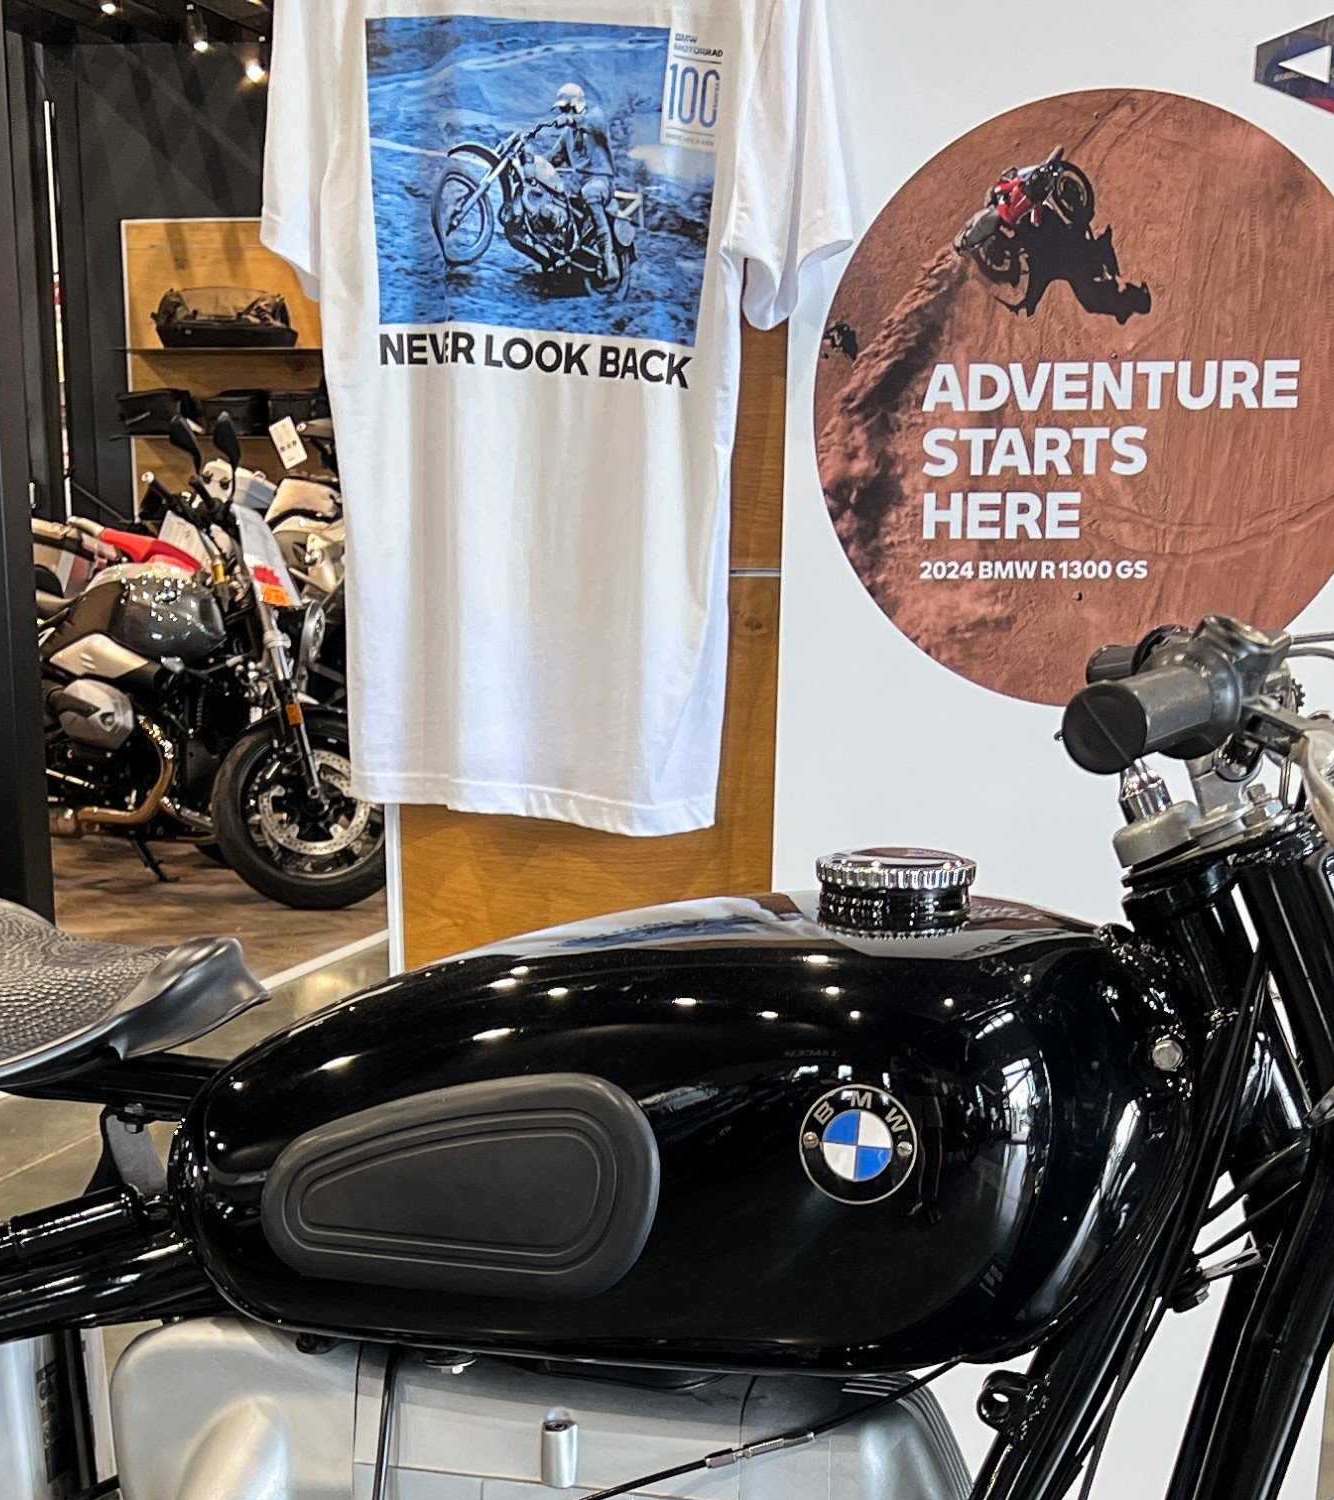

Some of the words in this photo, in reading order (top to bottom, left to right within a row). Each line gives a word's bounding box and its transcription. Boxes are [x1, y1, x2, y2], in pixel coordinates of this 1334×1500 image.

[673, 44, 724, 57] MOTORRAD
[668, 63, 721, 128] 100
[379, 331, 474, 367] NEVER
[483, 333, 593, 377] LOOK
[599, 346, 693, 390] BACK
[921, 359, 1300, 412] ADVENTURE
[921, 425, 1148, 477] STARTS
[921, 490, 1082, 541] HERE
[919, 560, 974, 580] 2024
[977, 560, 1037, 580] BMW
[1040, 560, 1057, 580] R
[1059, 560, 1113, 580] 1300
[1115, 560, 1149, 581] GS
[813, 1090, 909, 1133] BMW
